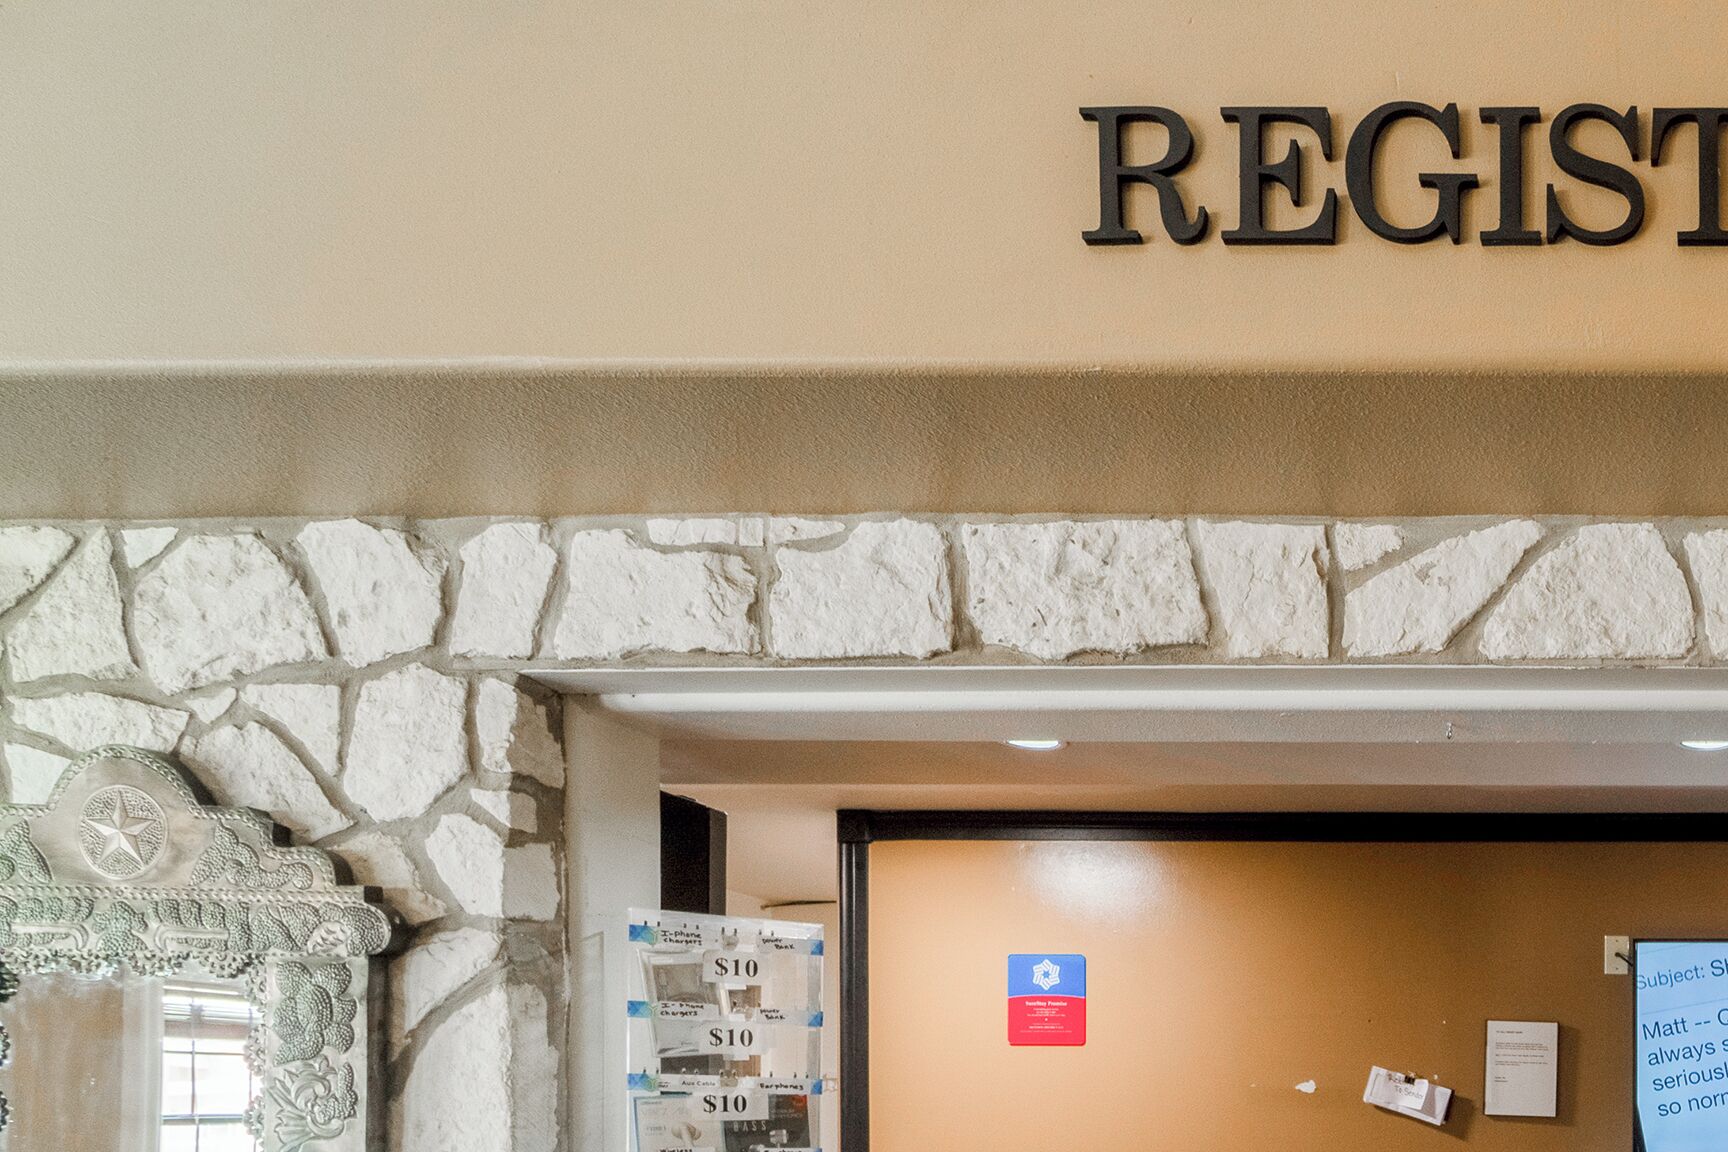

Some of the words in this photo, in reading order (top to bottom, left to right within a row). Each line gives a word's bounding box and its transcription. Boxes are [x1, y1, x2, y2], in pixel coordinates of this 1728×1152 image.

[715, 957, 759, 978] $10
[1637, 965, 1705, 990] Subject:
[709, 1028, 754, 1048] $10
[1642, 1017, 1688, 1040] Matt
[1648, 1041, 1716, 1067] always
[703, 1094, 747, 1114] $10
[1657, 1100, 1682, 1117] so
